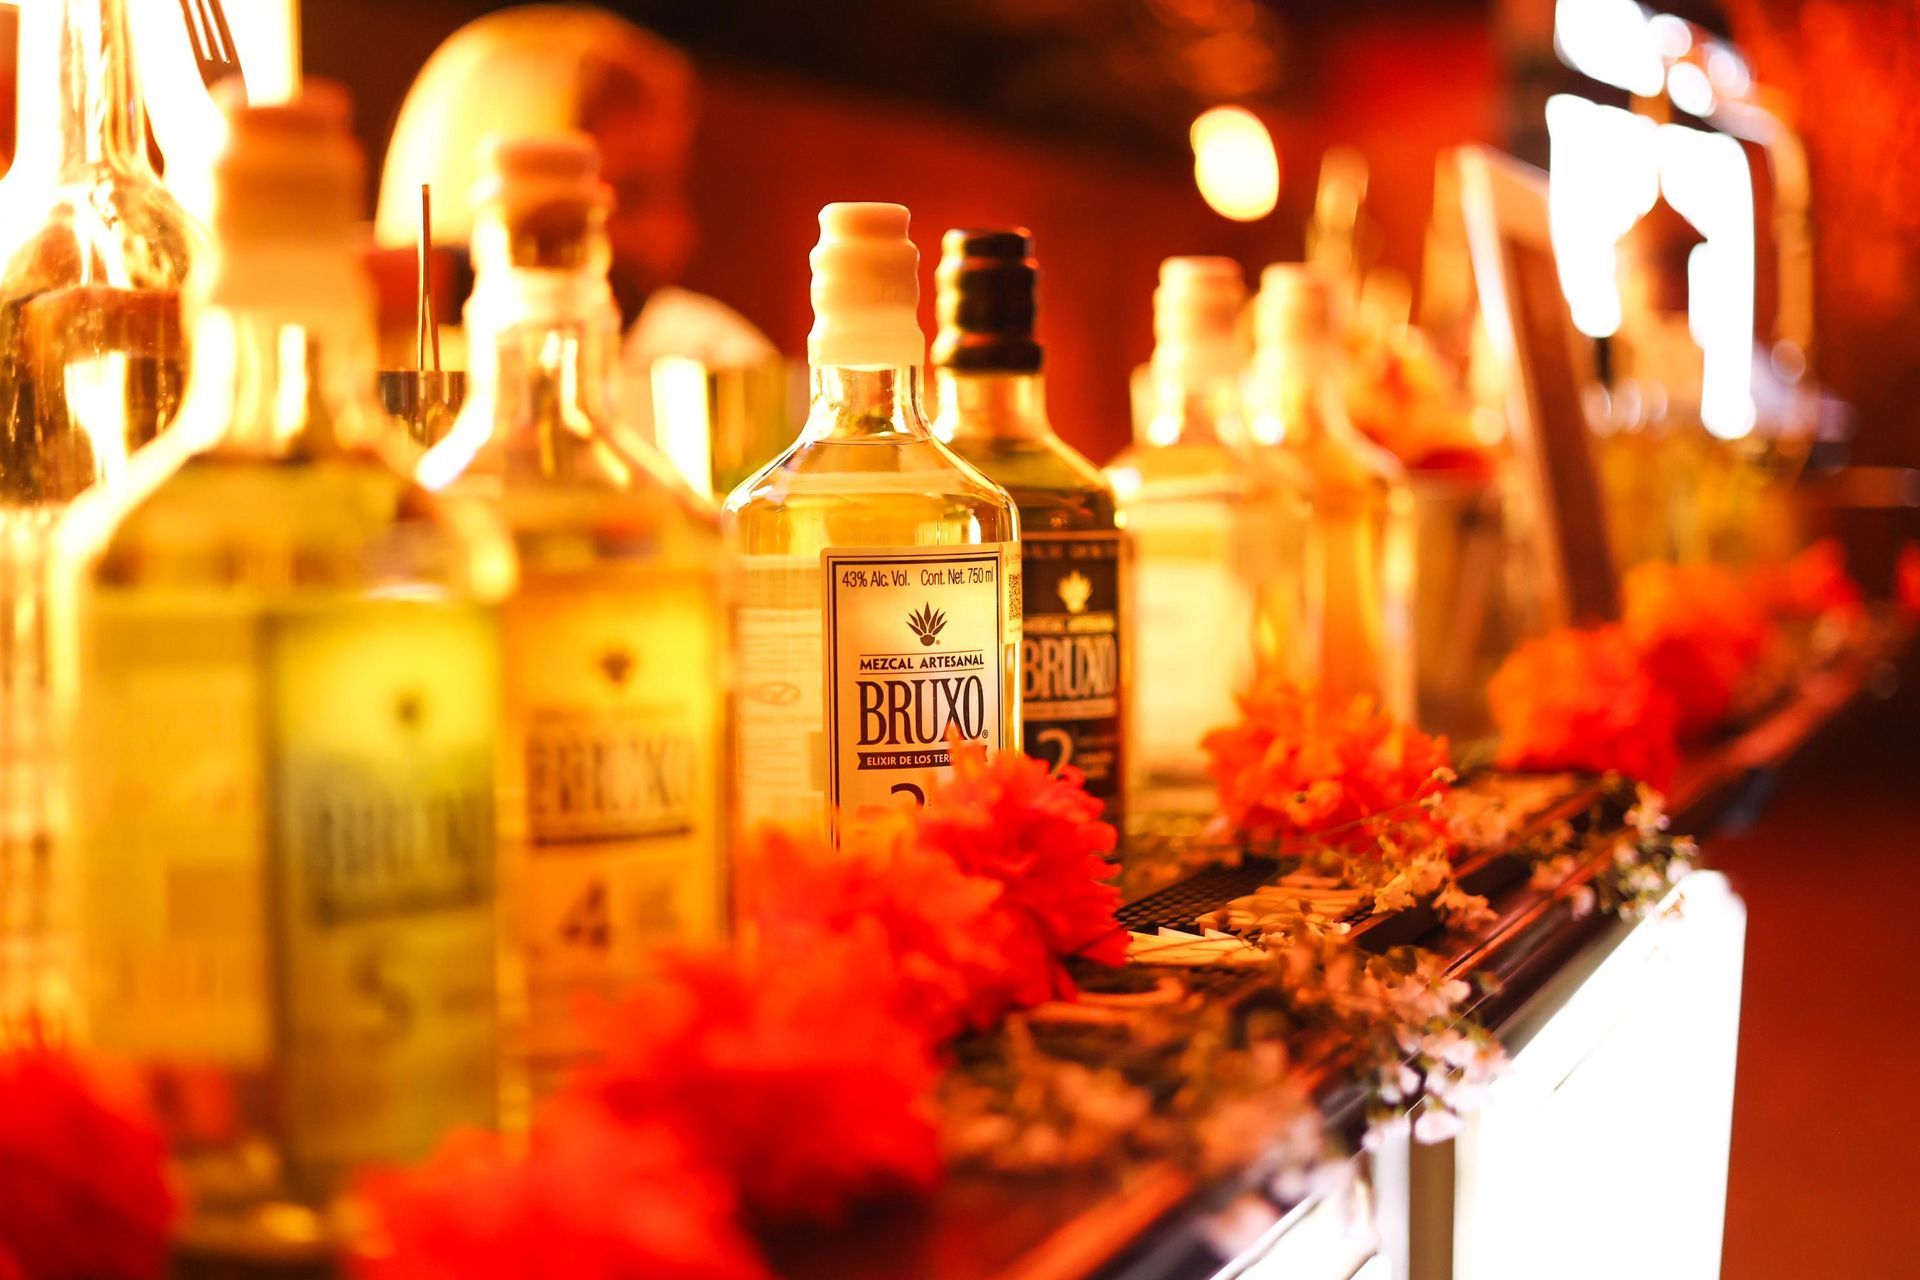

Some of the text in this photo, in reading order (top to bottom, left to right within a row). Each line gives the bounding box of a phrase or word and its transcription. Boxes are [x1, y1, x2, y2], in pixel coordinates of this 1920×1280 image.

[842, 566, 994, 587] 43% Alc. Vol. Cont. Net. 750 ml
[859, 653, 985, 671] MEZCAL ARTESANAL
[1022, 633, 1116, 698] BRUXO
[867, 756, 897, 766] ELIXIR
[899, 755, 912, 765] DE
[914, 754, 932, 764] LOS
